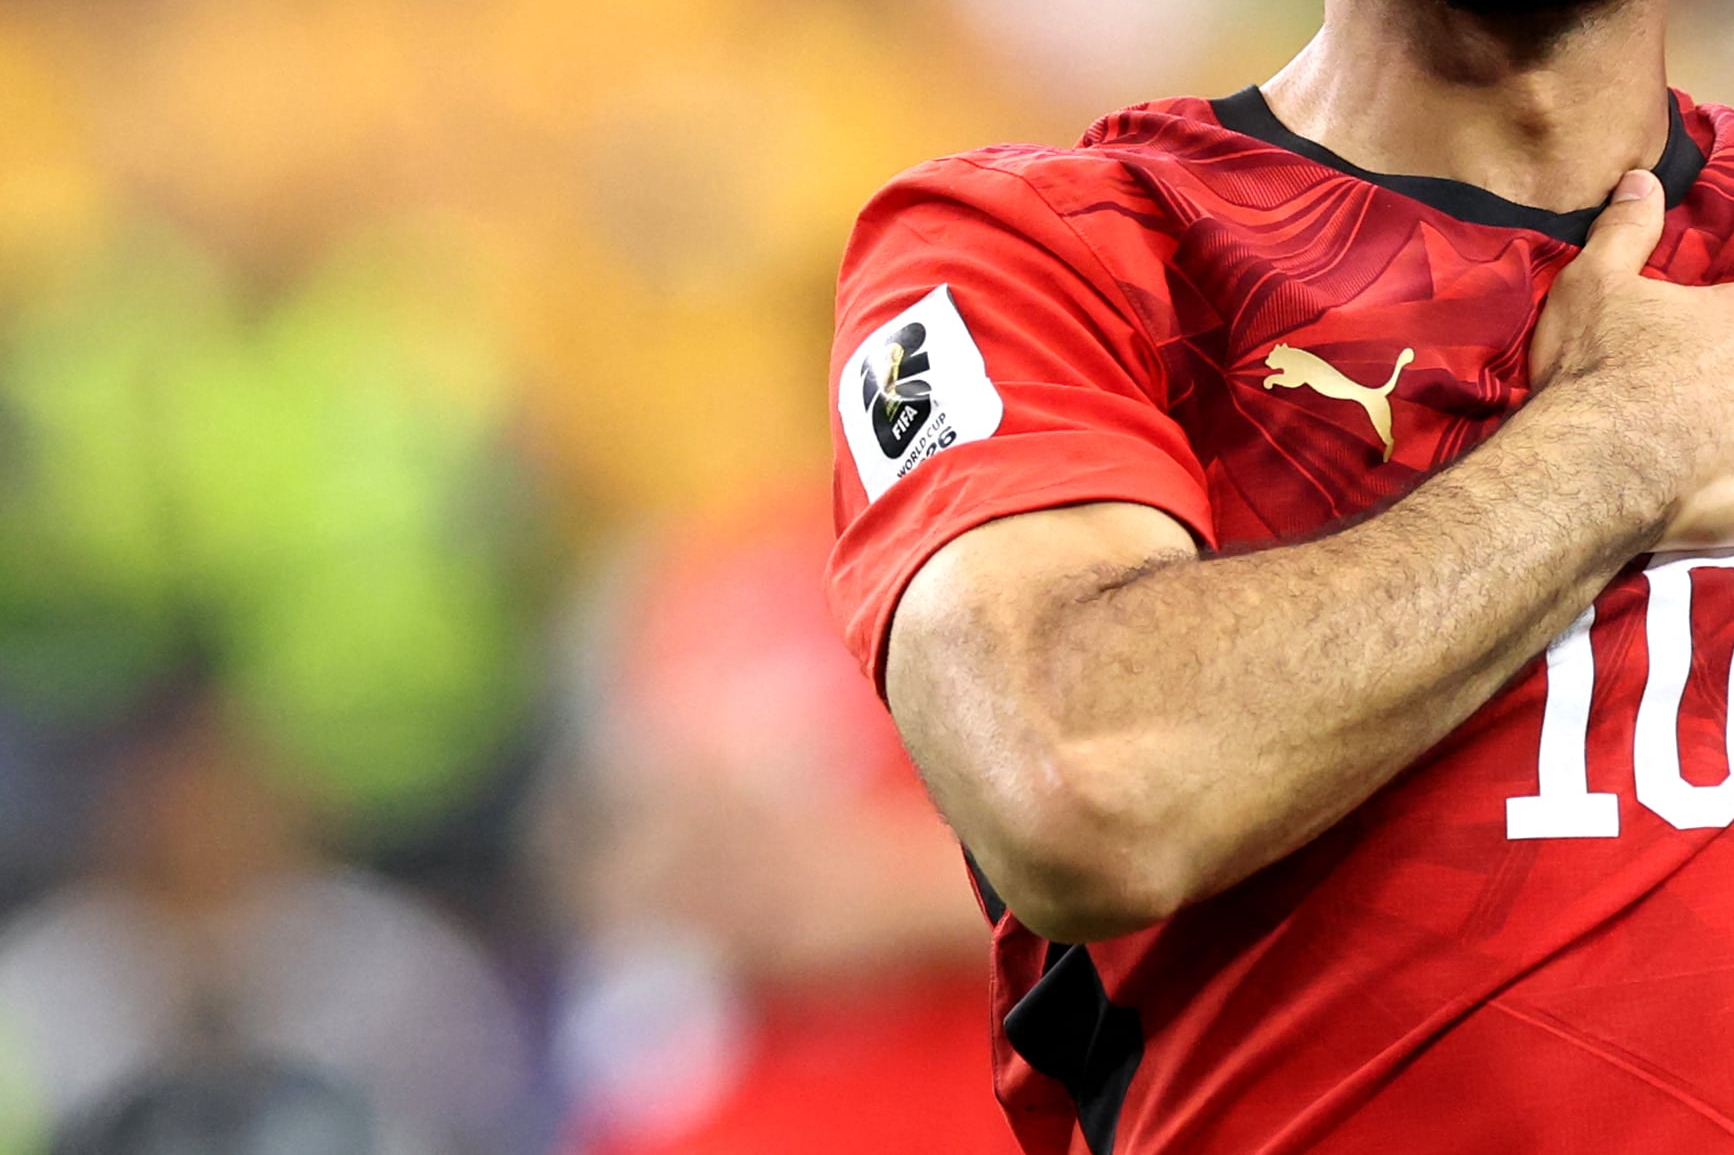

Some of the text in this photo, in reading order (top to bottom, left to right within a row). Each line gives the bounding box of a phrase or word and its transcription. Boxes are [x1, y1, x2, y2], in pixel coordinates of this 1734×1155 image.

[891, 405, 919, 441] FIFA
[897, 412, 947, 478] WORLD CUP
[918, 425, 958, 464] 26
